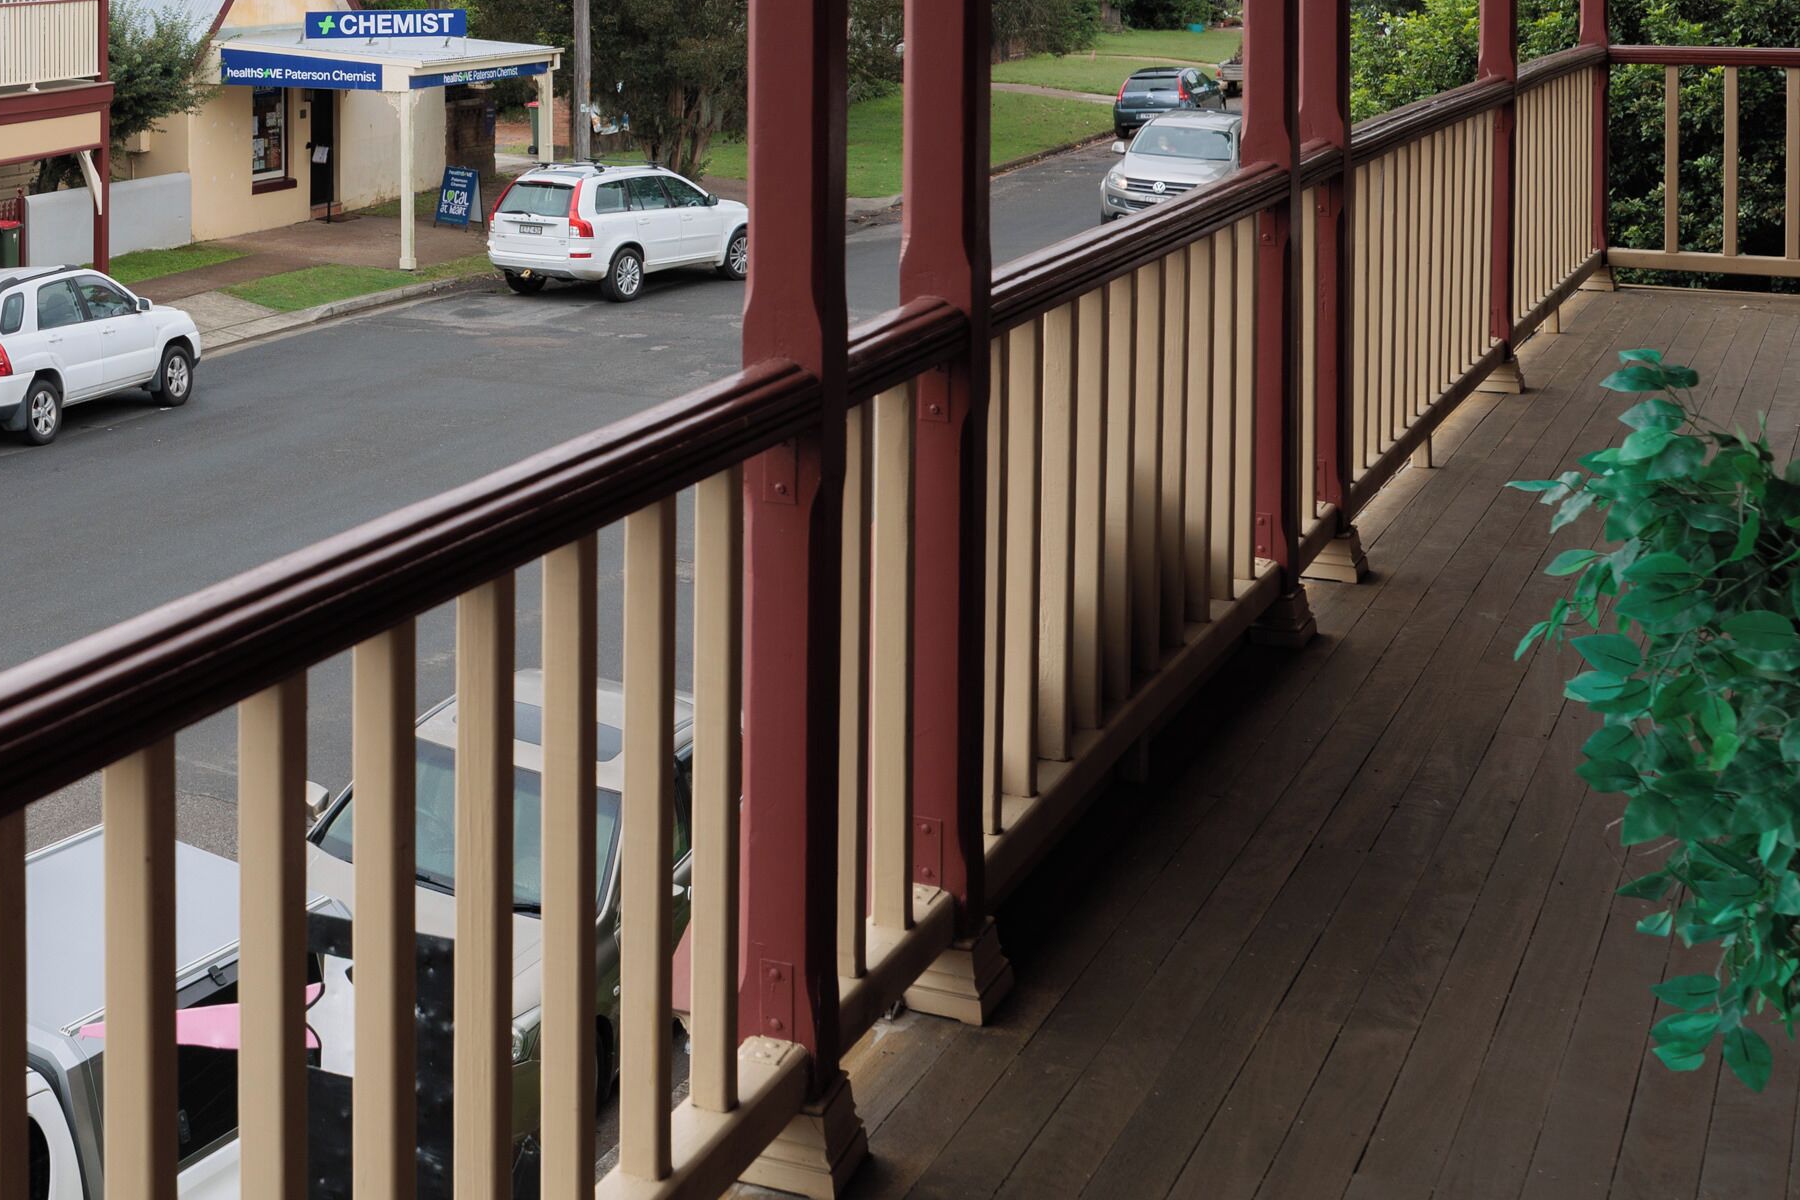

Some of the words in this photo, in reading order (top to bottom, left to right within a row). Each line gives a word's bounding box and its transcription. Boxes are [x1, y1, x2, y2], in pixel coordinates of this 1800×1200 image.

[339, 13, 454, 35] CHEMIST
[285, 69, 331, 81] Paterson
[332, 70, 376, 82] Chemist
[473, 69, 497, 80] Paterson
[497, 67, 518, 77] Chemist
